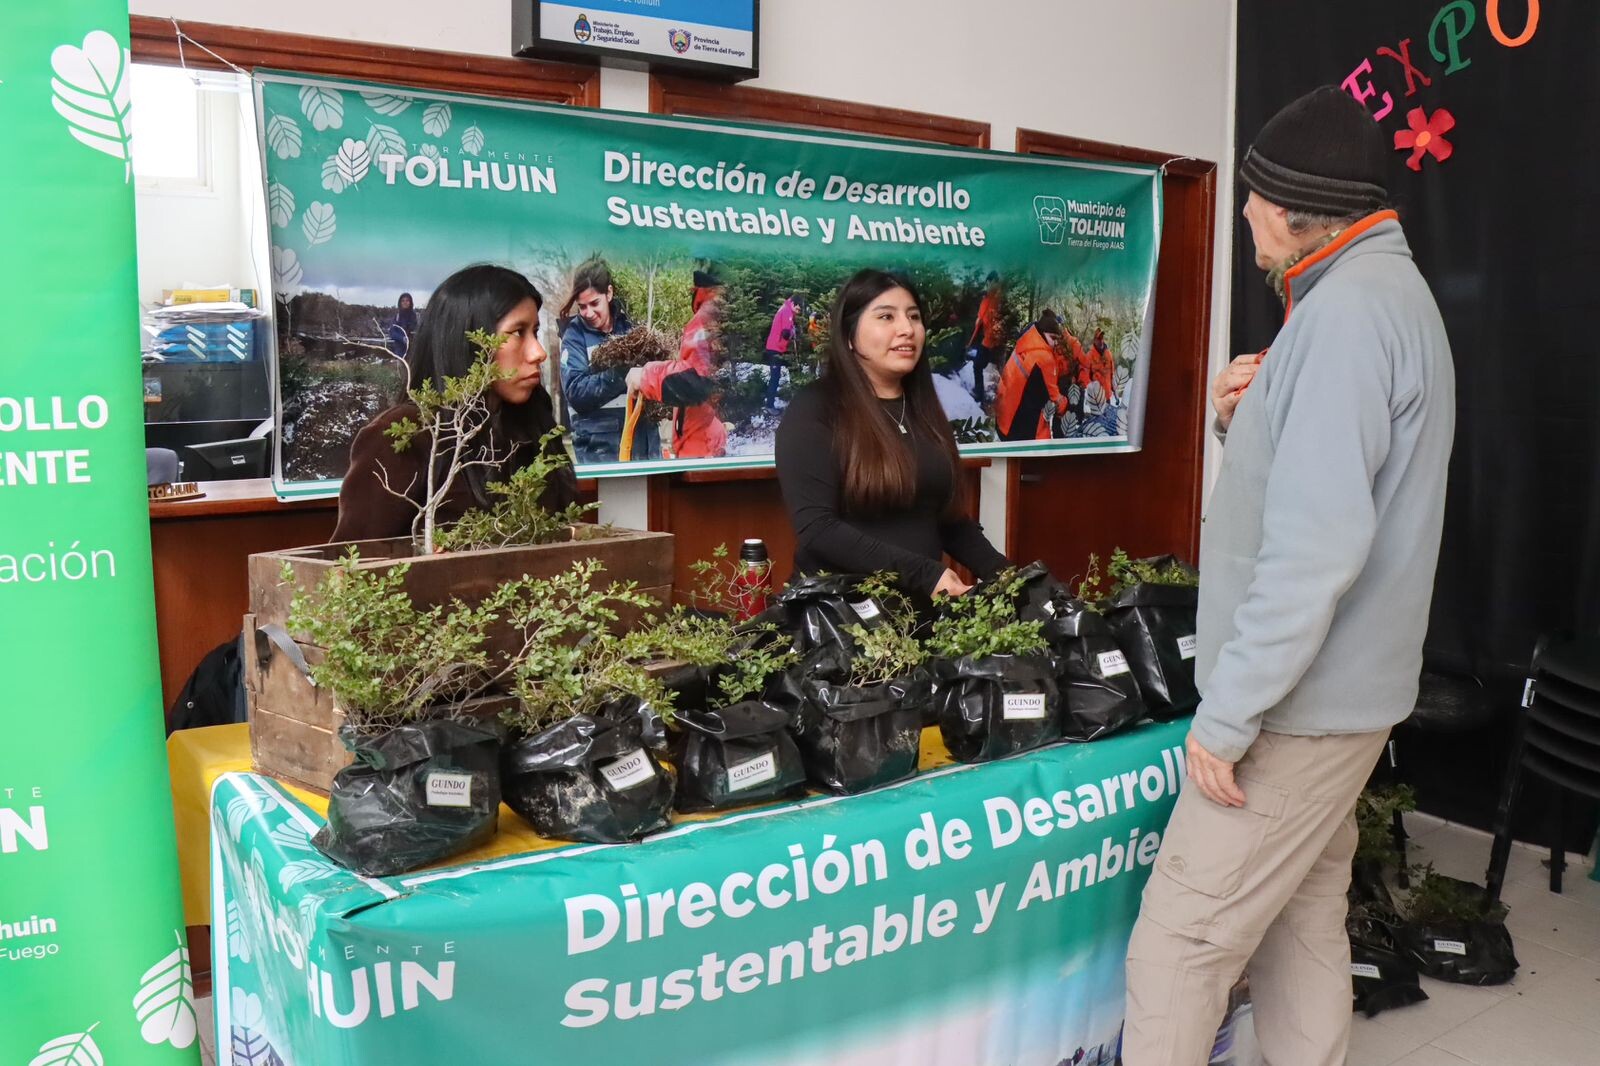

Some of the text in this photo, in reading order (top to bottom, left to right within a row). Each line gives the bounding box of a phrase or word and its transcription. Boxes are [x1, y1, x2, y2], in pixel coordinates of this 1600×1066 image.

[593, 27, 635, 37] Trabajo, Empleo
[597, 35, 623, 43] Seguridad
[694, 36, 720, 45] Provincia
[728, 49, 745, 57] Fuego
[1341, 0, 1540, 122] EXPO
[379, 154, 557, 194] TOLHUIN
[604, 150, 970, 210] Dirección de Desarrollo
[1067, 200, 1126, 218] Municipio de
[607, 196, 986, 247] Sustentable y Ambiente
[1069, 217, 1125, 238] TOLHUIN
[1067, 237, 1083, 247] Tierra
[1093, 240, 1109, 250] Fuego
[0, 449, 91, 485] NTE
[0, 540, 115, 583] ación
[607, 757, 641, 777] GUINDO
[734, 760, 769, 777] GUINDO
[431, 779, 466, 790] GUINDO
[564, 745, 1188, 956] Dirección de Desarroll
[0, 915, 57, 940] huin
[560, 827, 1161, 1029] Sustentable y Ambie
